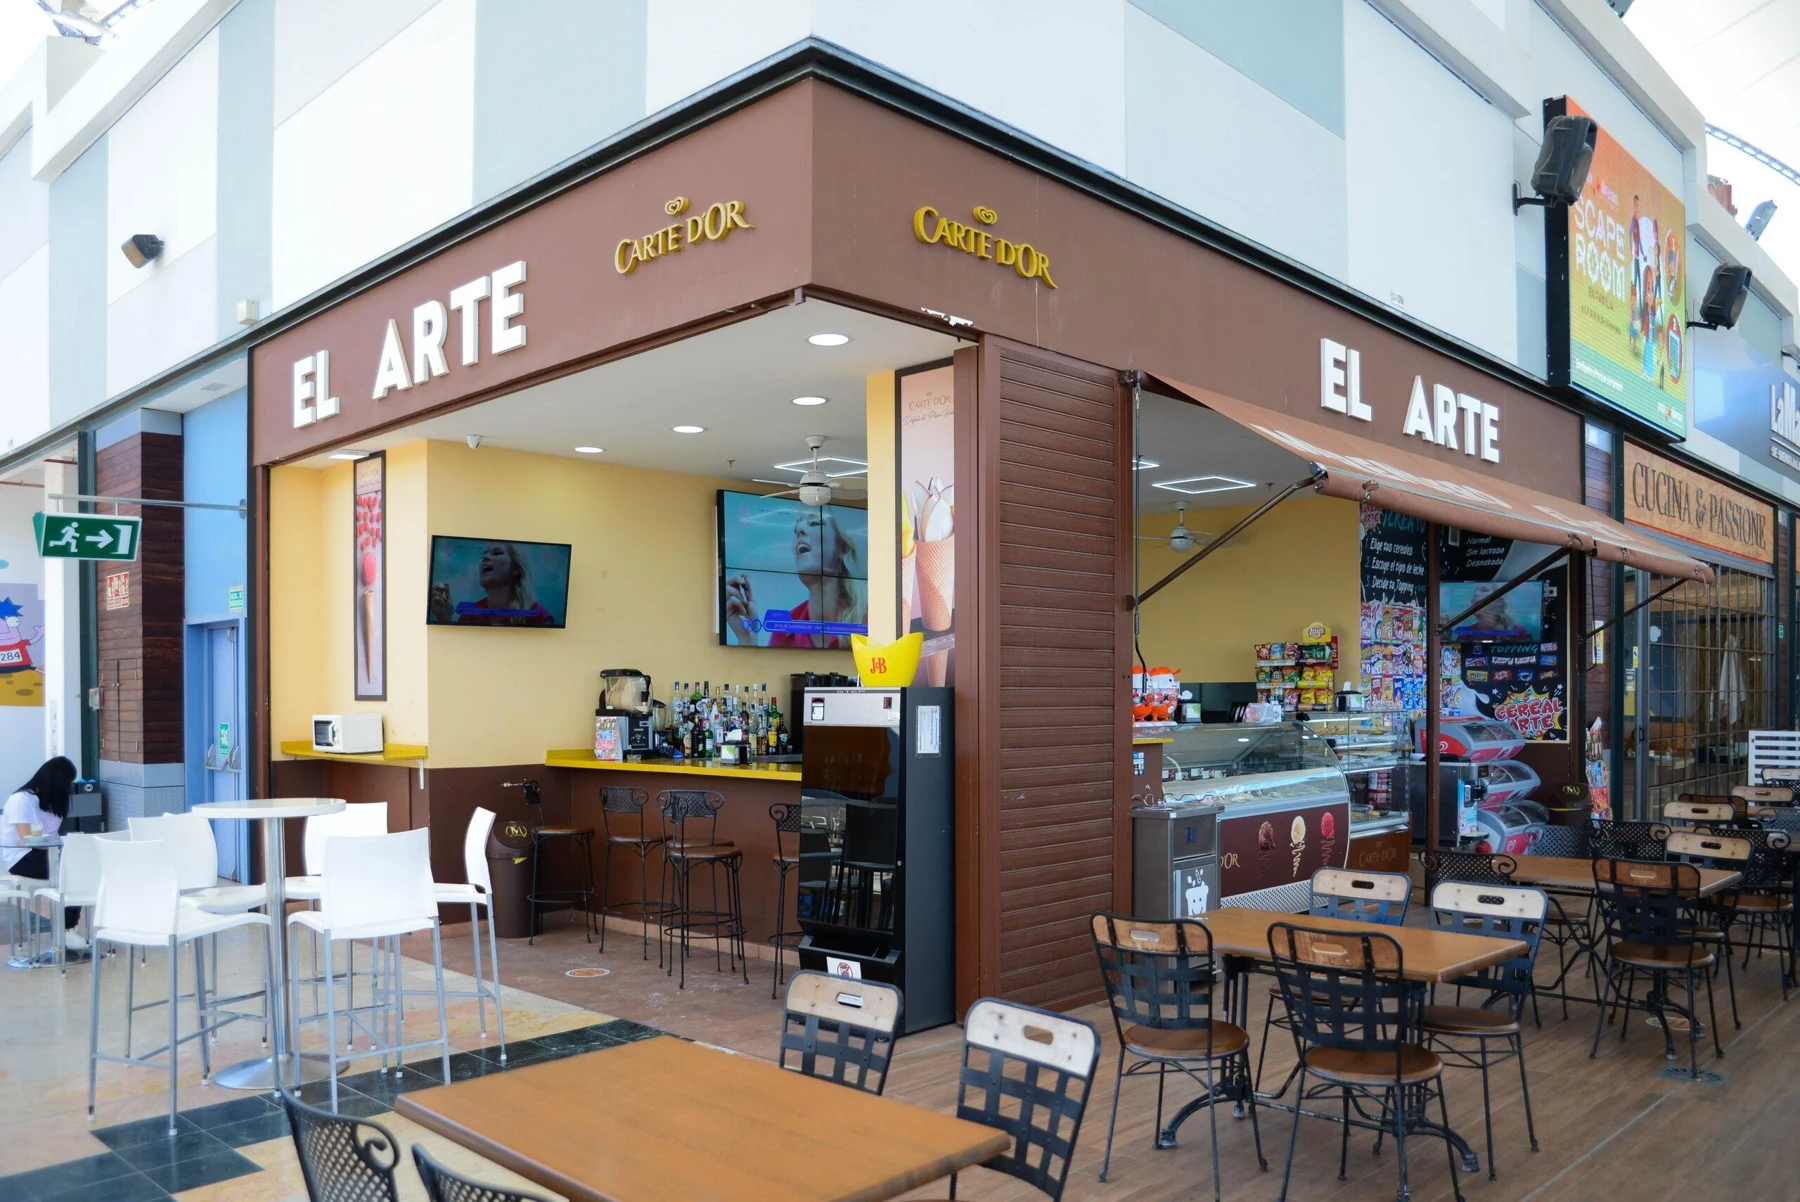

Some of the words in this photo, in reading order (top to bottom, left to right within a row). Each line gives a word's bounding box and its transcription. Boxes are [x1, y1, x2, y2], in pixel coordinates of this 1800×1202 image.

[615, 226, 684, 275] CARTE
[687, 200, 756, 244] D'OR
[913, 206, 992, 260] CARTE
[996, 243, 1058, 289] D'OR
[1575, 232, 1625, 303] ROOM
[293, 349, 340, 429] EL
[373, 260, 527, 400] ARTE
[1320, 338, 1373, 422] EL
[1403, 375, 1499, 463] ARTE
[1466, 535, 1491, 545] Normal
[1632, 462, 1692, 524] CUCINA
[1696, 487, 1706, 529] &
[1709, 492, 1766, 550] PASSIONE
[1490, 644, 1539, 654] TOPPING
[1494, 697, 1563, 721] CEREAL
[1509, 713, 1555, 732] ARTE
[1358, 851, 1380, 868] CARTE
